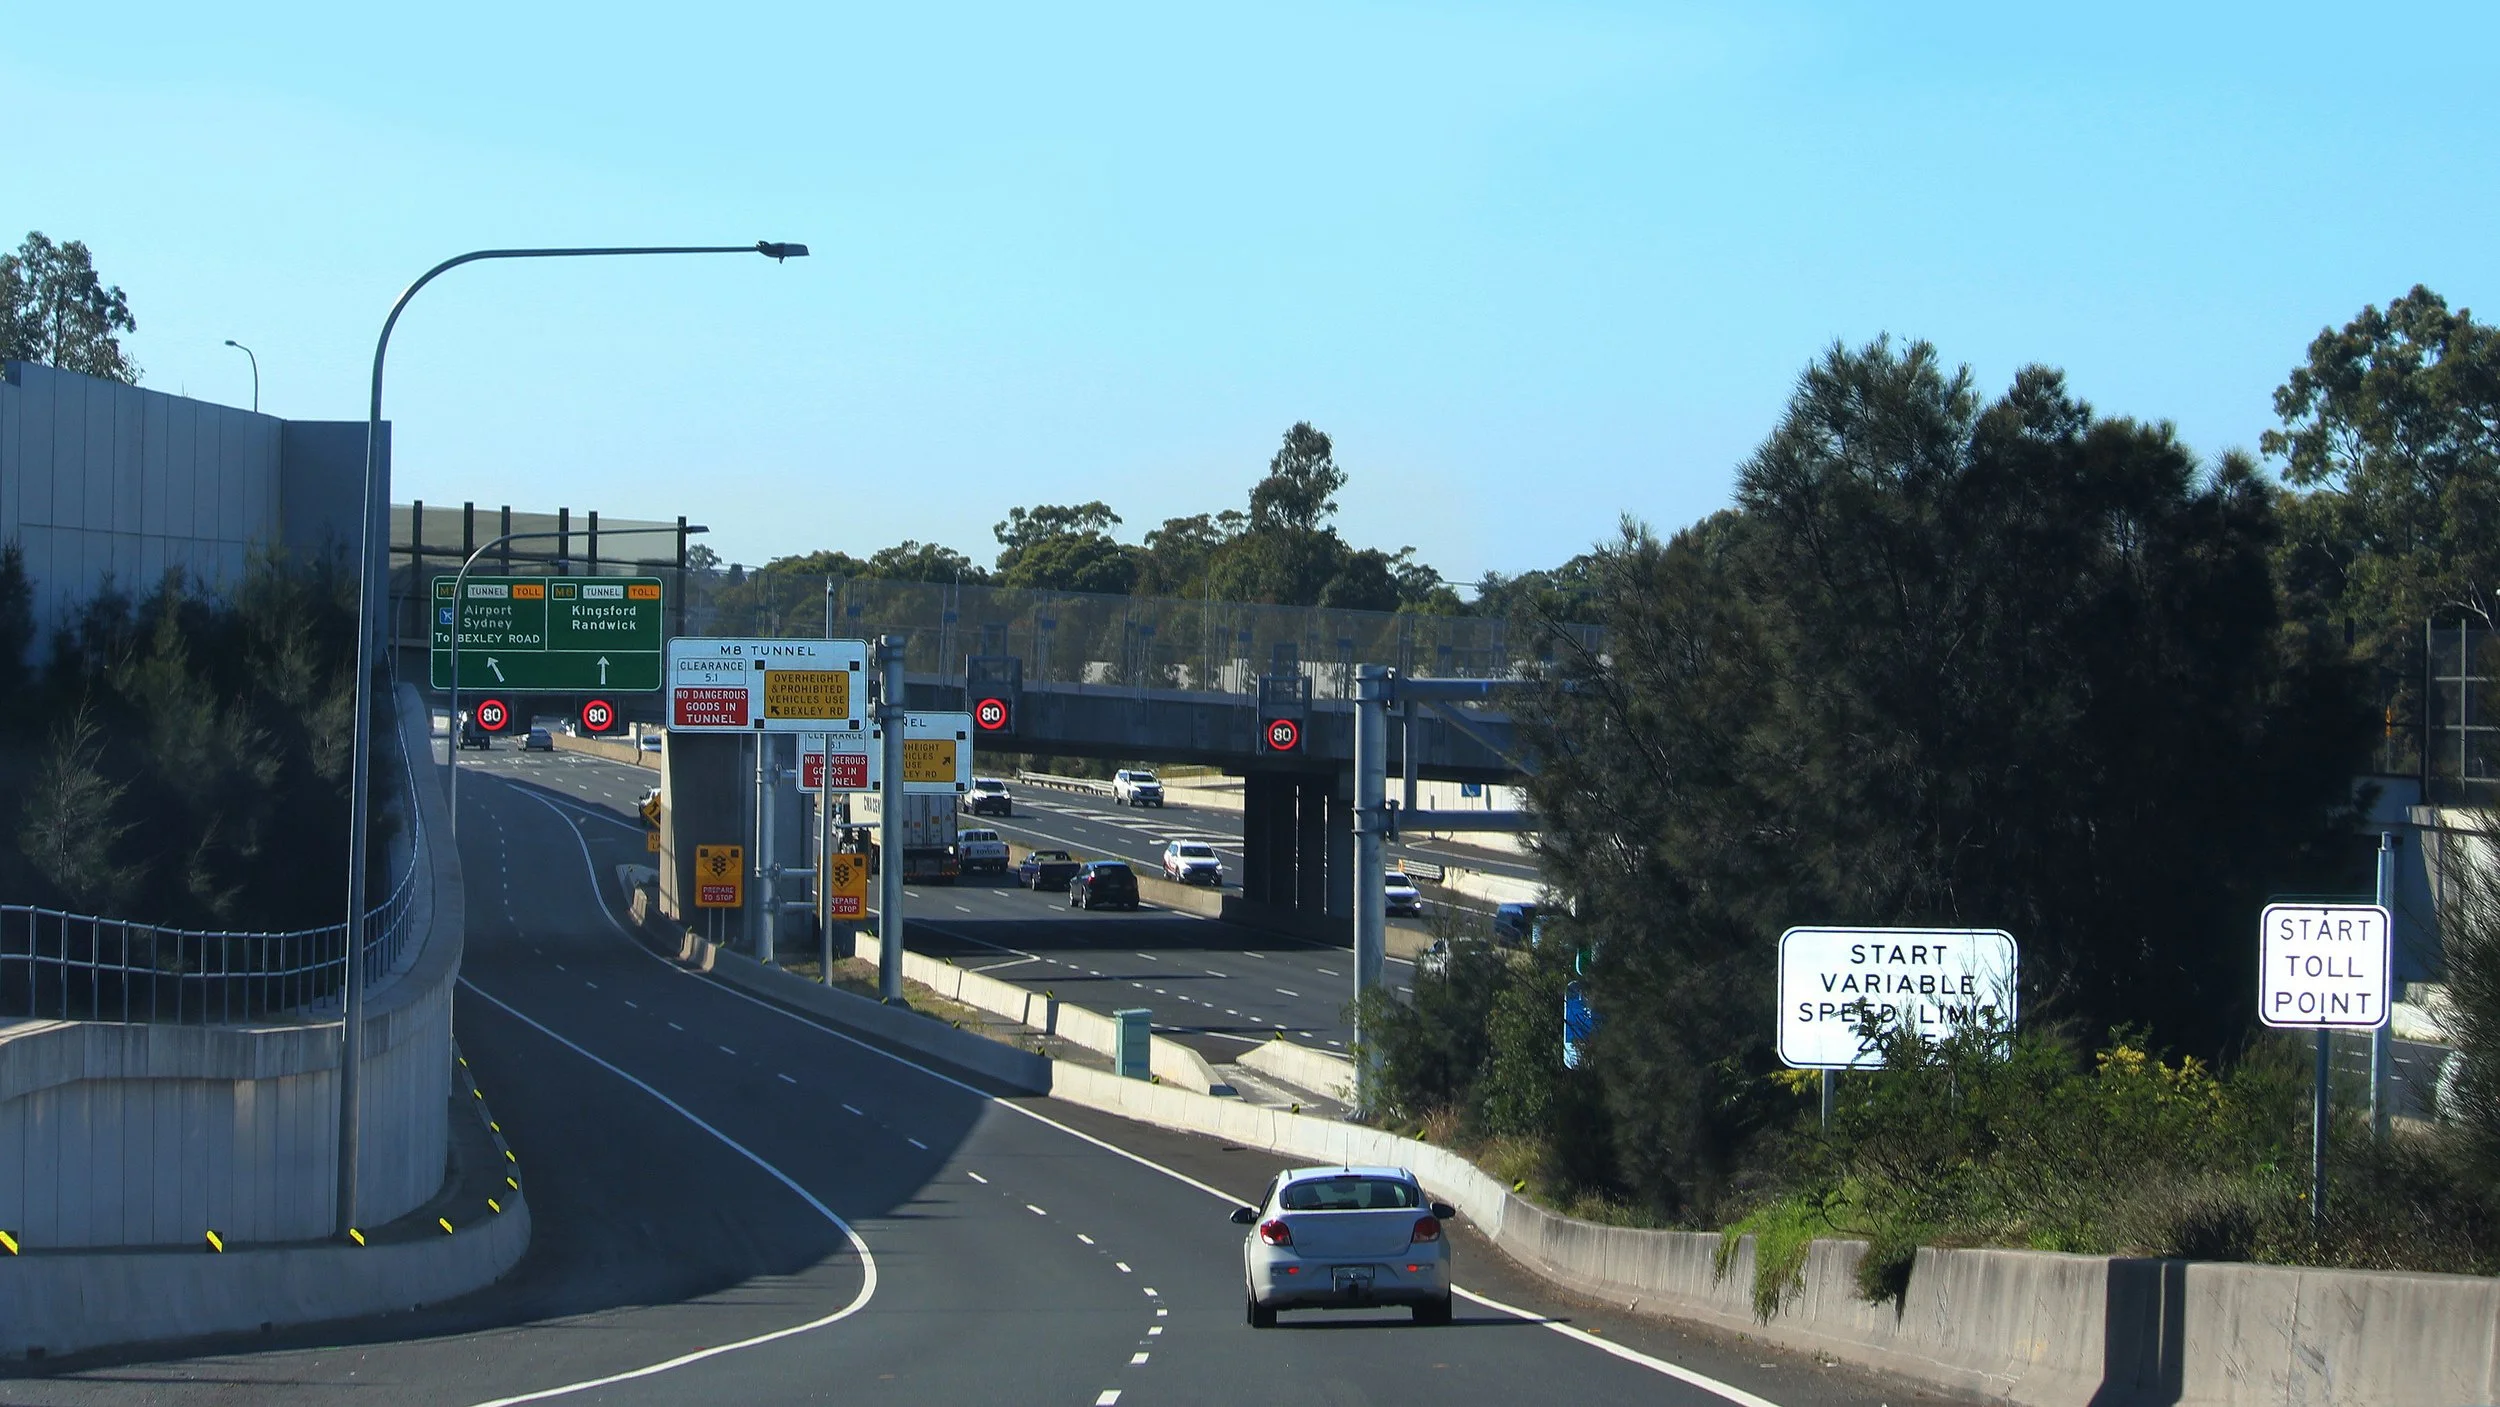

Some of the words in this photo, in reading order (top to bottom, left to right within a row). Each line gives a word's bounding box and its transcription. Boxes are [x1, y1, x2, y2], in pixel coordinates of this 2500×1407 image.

[471, 587, 504, 596] TUNNEL
[516, 587, 540, 596] TOLL
[586, 587, 620, 597] TUNNEL
[632, 588, 656, 597] TOLL
[464, 604, 512, 617] Airport
[572, 605, 637, 618] Kingsford
[464, 617, 512, 630] Sydney
[572, 619, 637, 630] Randwick
[435, 632, 450, 643] To
[457, 633, 503, 643] BEXLEY
[508, 633, 541, 643] ROAD
[720, 645, 742, 655] M8
[751, 645, 816, 656] TUNNEL
[680, 661, 744, 671] CLEARANCE
[705, 673, 718, 683] 5.1
[774, 673, 840, 683] OVERHEIGHT
[771, 684, 778, 694] &
[780, 684, 843, 694] PROHIBITED
[676, 690, 689, 699] NO
[693, 690, 746, 700] DANGEROUS
[768, 695, 820, 704] VEHICLES
[825, 695, 845, 704] USE
[685, 702, 720, 711] GOODS
[725, 702, 736, 711] IN
[783, 706, 823, 715] BEXLEY
[829, 706, 843, 716] RD
[483, 708, 501, 722] 80
[588, 708, 607, 722] 80
[686, 714, 736, 724] TUNNEL
[981, 706, 1000, 722] 80
[1273, 727, 1292, 742] 80
[804, 756, 815, 764] NO
[818, 756, 866, 765] DNGEROUS
[905, 761, 922, 769] USE
[812, 767, 843, 775] GODS
[847, 767, 857, 775] IN
[925, 770, 937, 778] RD
[813, 777, 857, 786] TUNEL
[703, 886, 734, 894] PREPARE
[716, 894, 734, 902] STOP
[832, 897, 858, 905] REPARE
[839, 905, 857, 913] STOP
[2280, 918, 2371, 941] START
[1850, 944, 1947, 965] START
[2285, 955, 2364, 978] TOLL
[1820, 973, 1976, 995] VARIABLE
[2275, 991, 2372, 1014] POINT
[1798, 1002, 1897, 1024] SPEED
